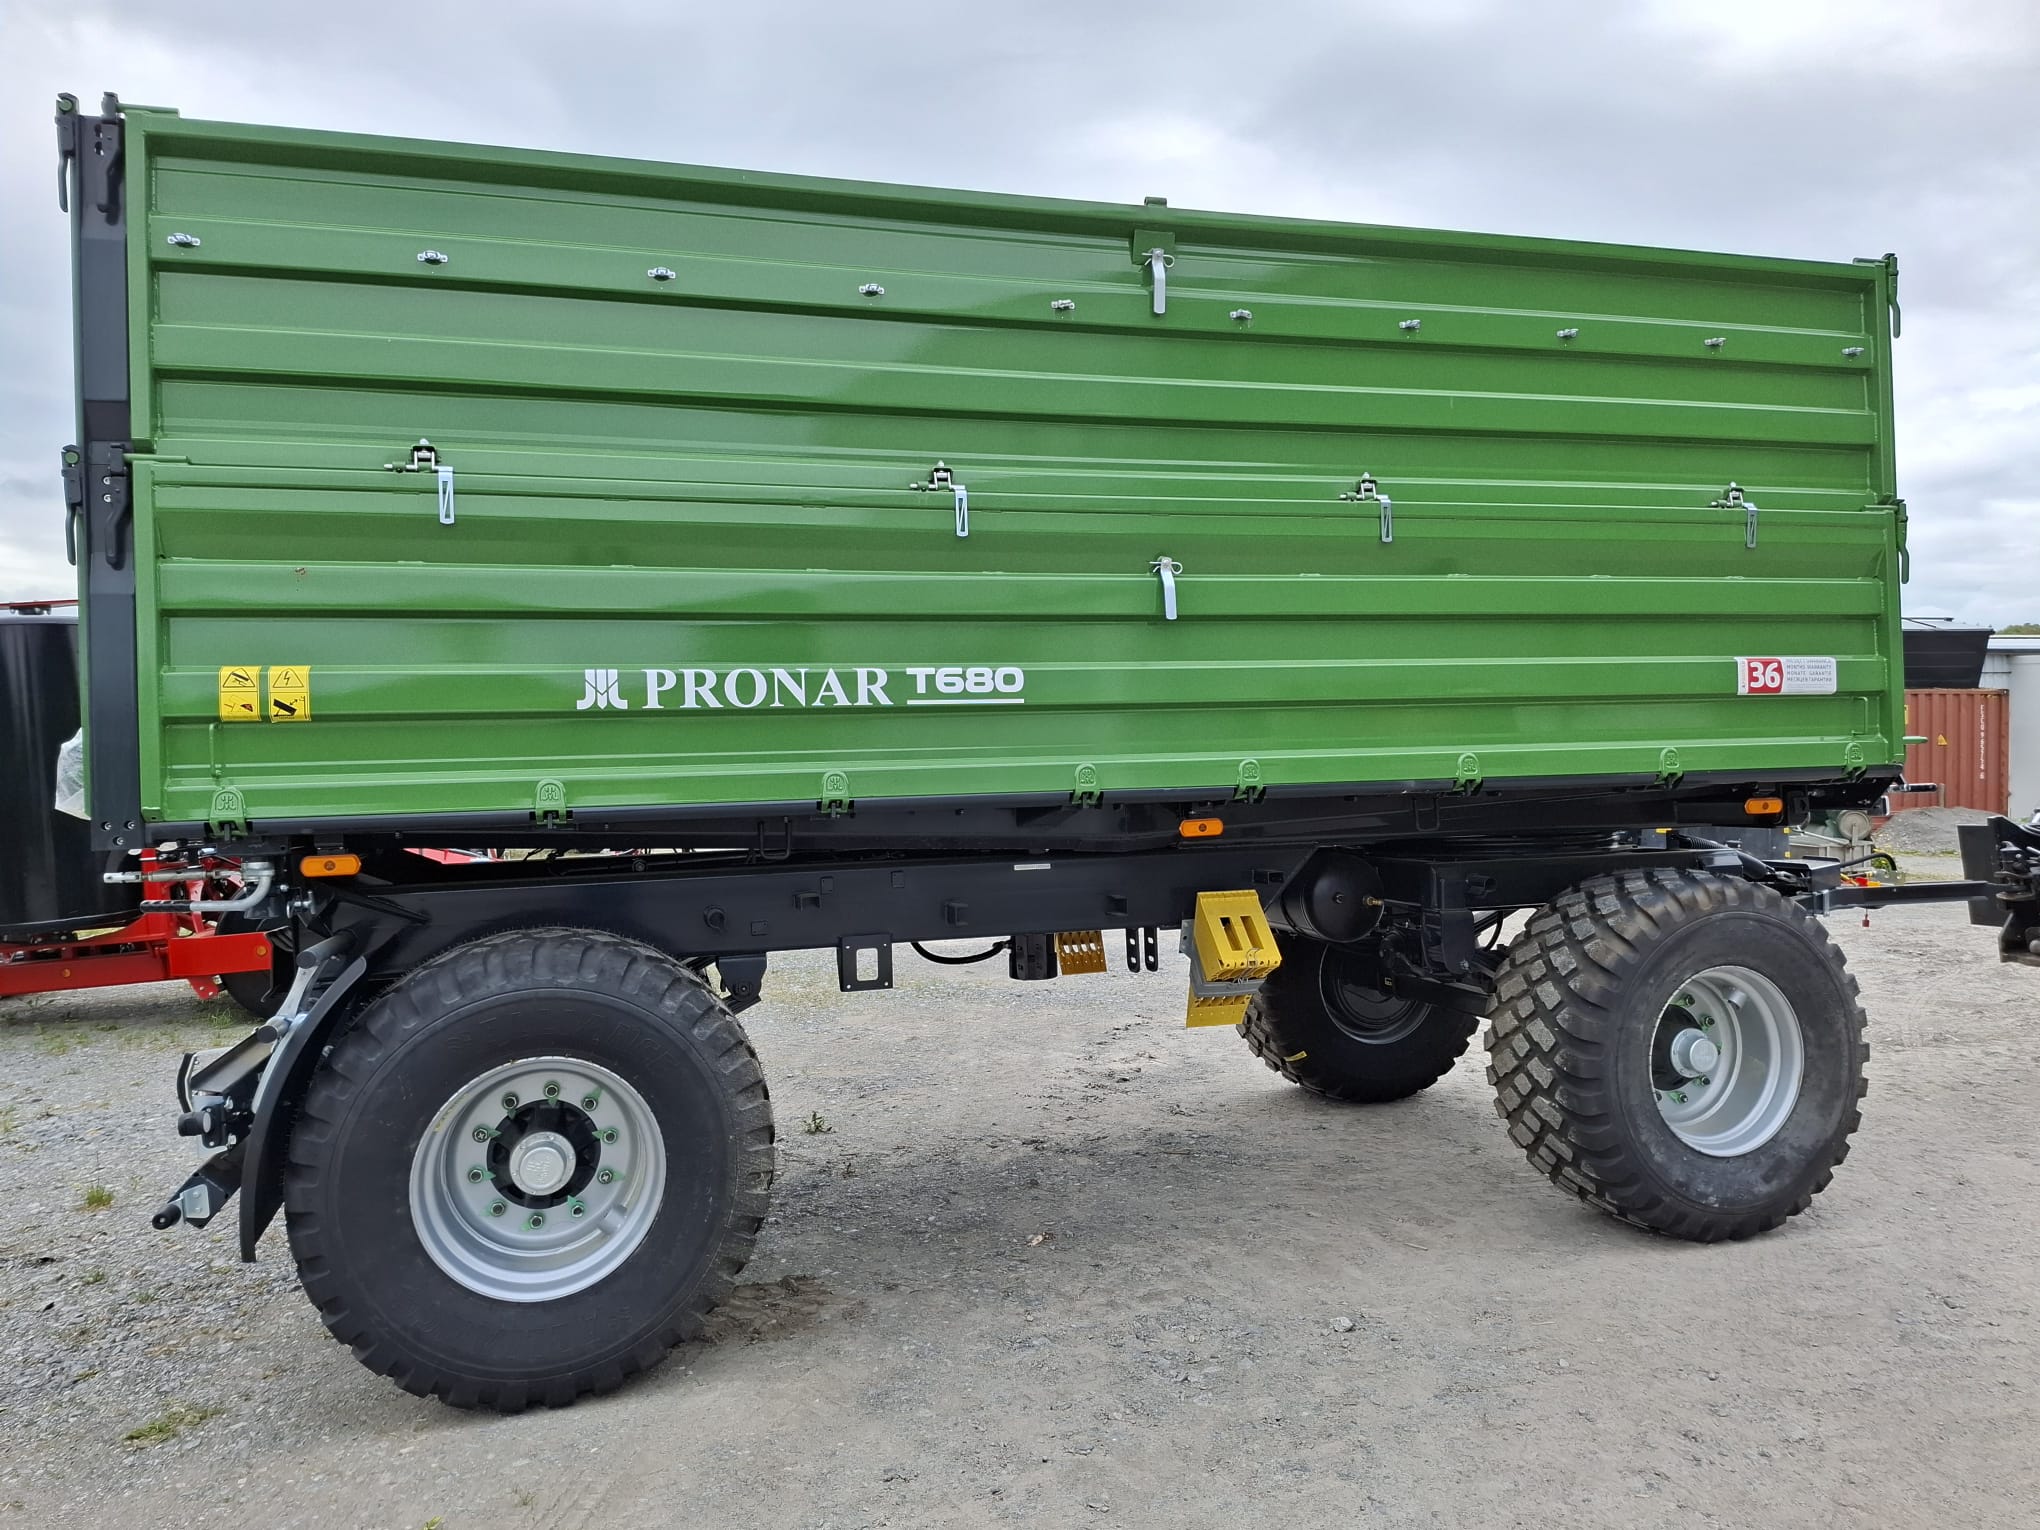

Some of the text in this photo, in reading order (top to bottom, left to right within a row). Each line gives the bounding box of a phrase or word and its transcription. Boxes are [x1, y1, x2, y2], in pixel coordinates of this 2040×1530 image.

[642, 667, 1025, 709] PRONAR T680
[1750, 661, 1780, 688] 36
